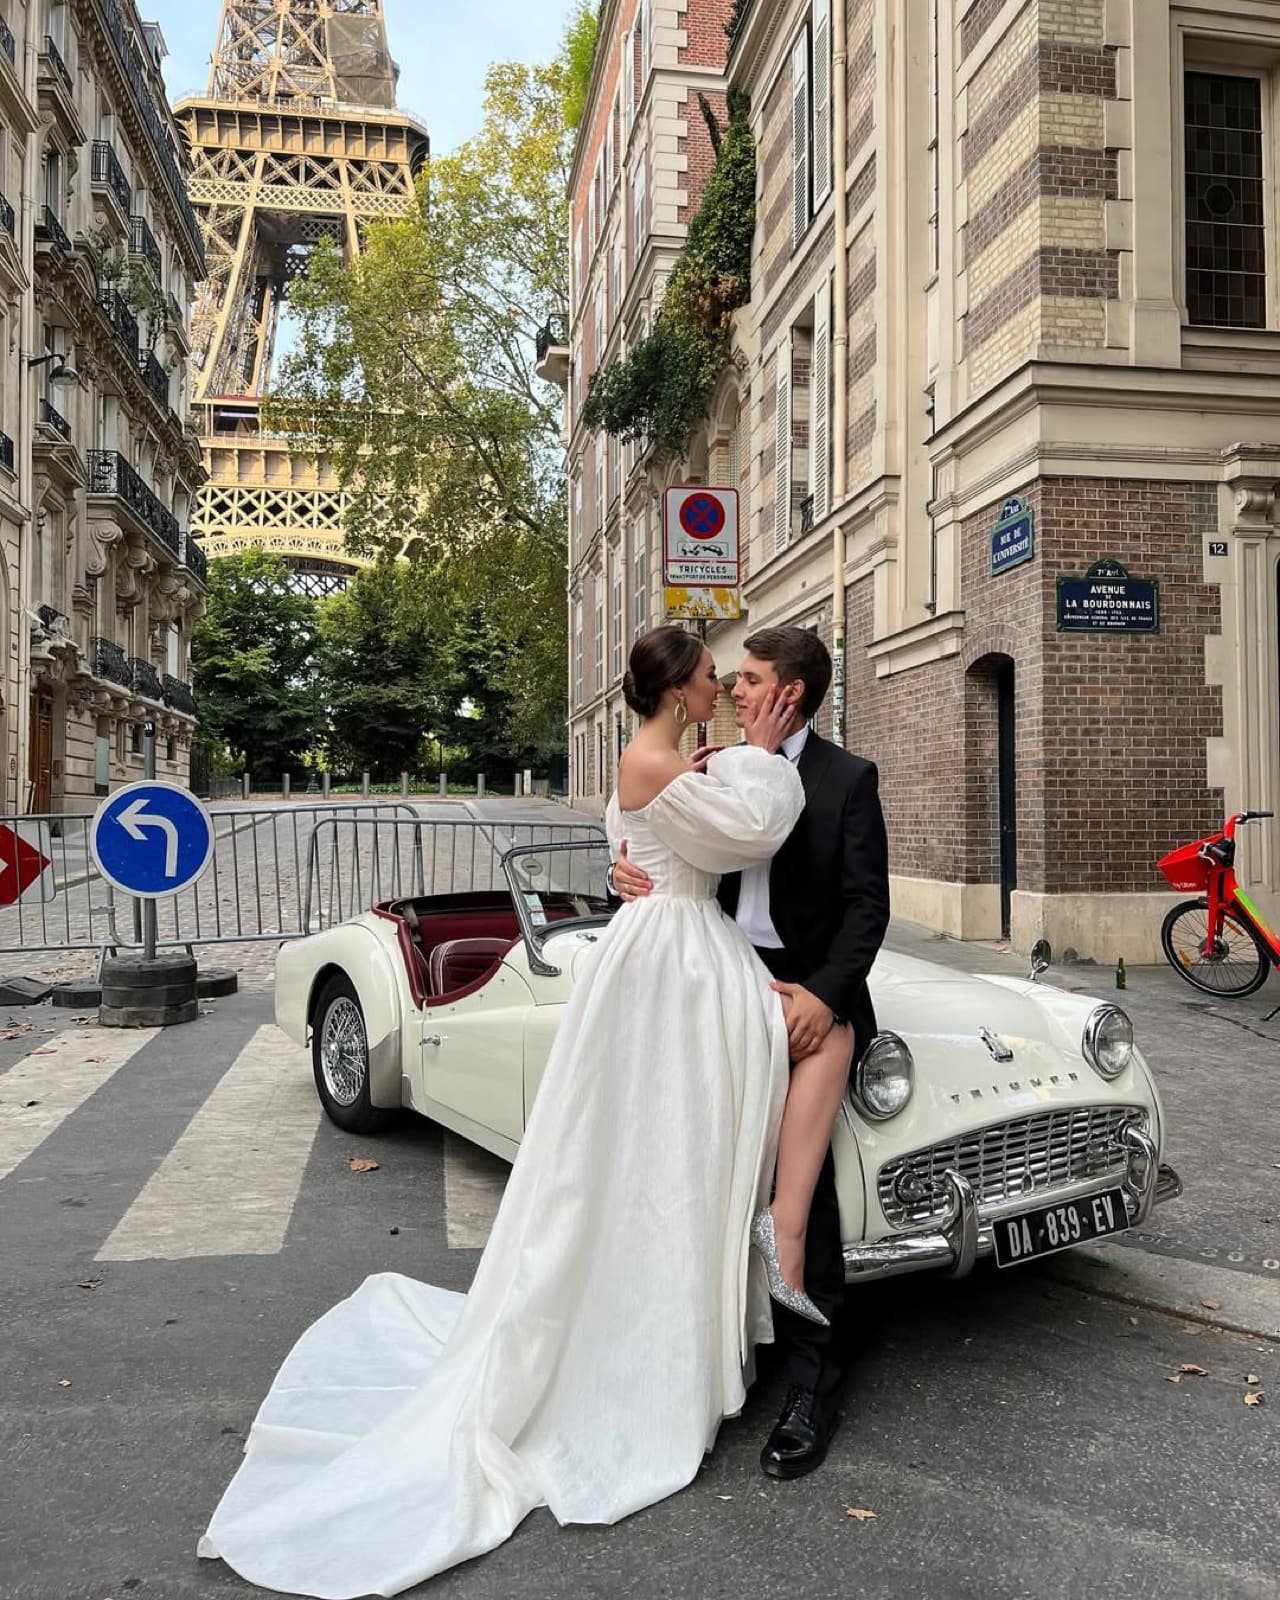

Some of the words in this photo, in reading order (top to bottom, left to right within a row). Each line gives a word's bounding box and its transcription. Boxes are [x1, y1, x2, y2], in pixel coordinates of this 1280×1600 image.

[1001, 532, 1011, 546] RUE
[1212, 543, 1225, 555] 12
[679, 565, 727, 574] TRICYCLES
[1090, 586, 1126, 594] AVENUE
[1066, 600, 1077, 608] LA
[1083, 599, 1151, 610] BOURDONNAIS
[951, 1072, 1078, 1104] TRIUMPH
